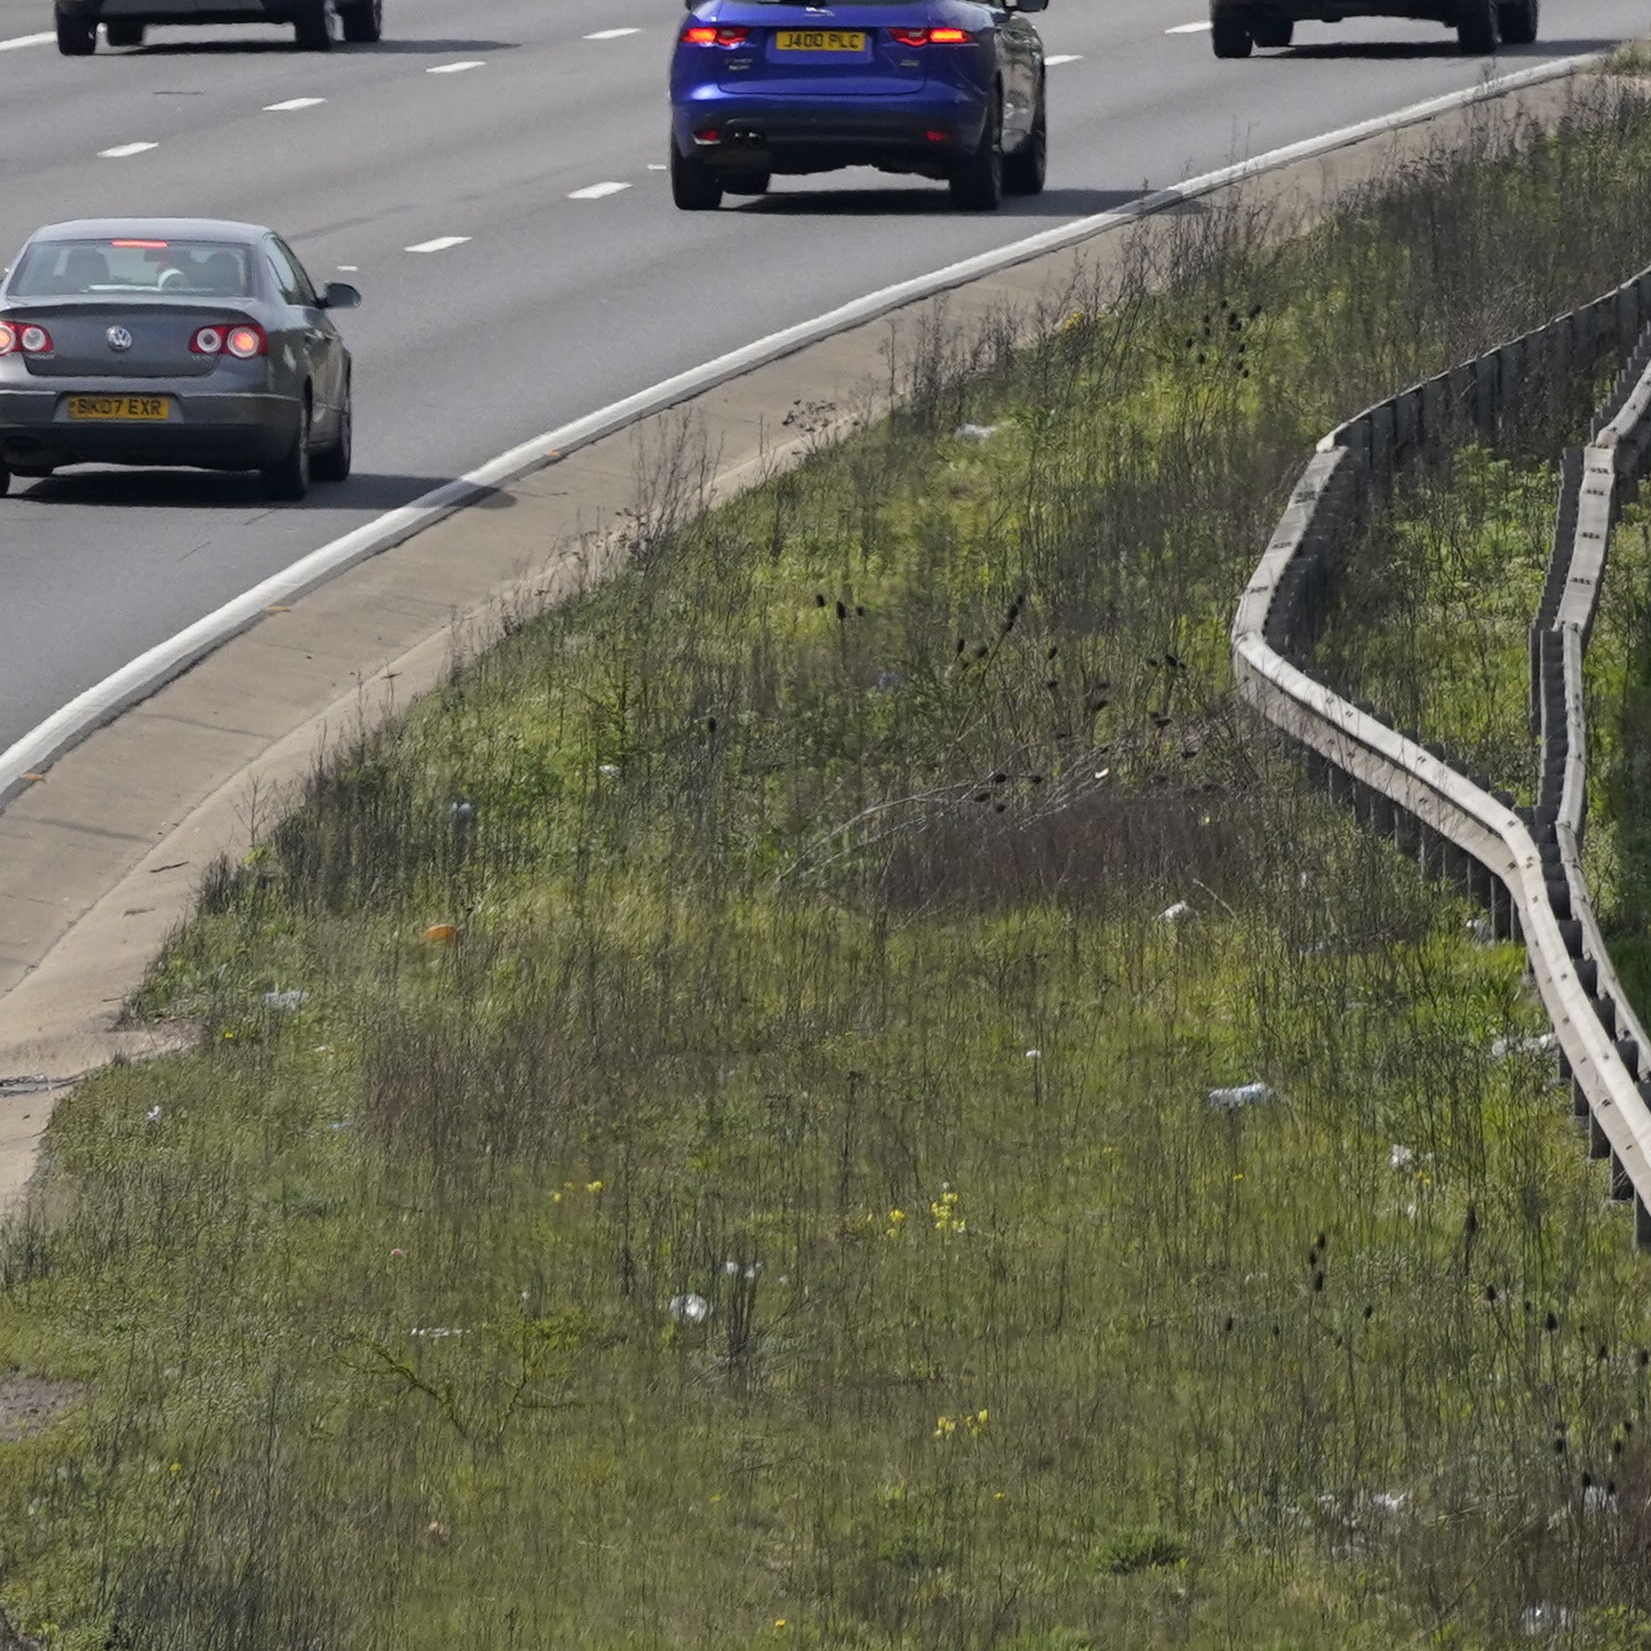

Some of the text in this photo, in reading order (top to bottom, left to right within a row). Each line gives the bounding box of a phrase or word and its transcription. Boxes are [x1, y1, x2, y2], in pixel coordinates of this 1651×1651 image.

[783, 33, 860, 49] J400 PLC
[127, 399, 162, 415] EXR
